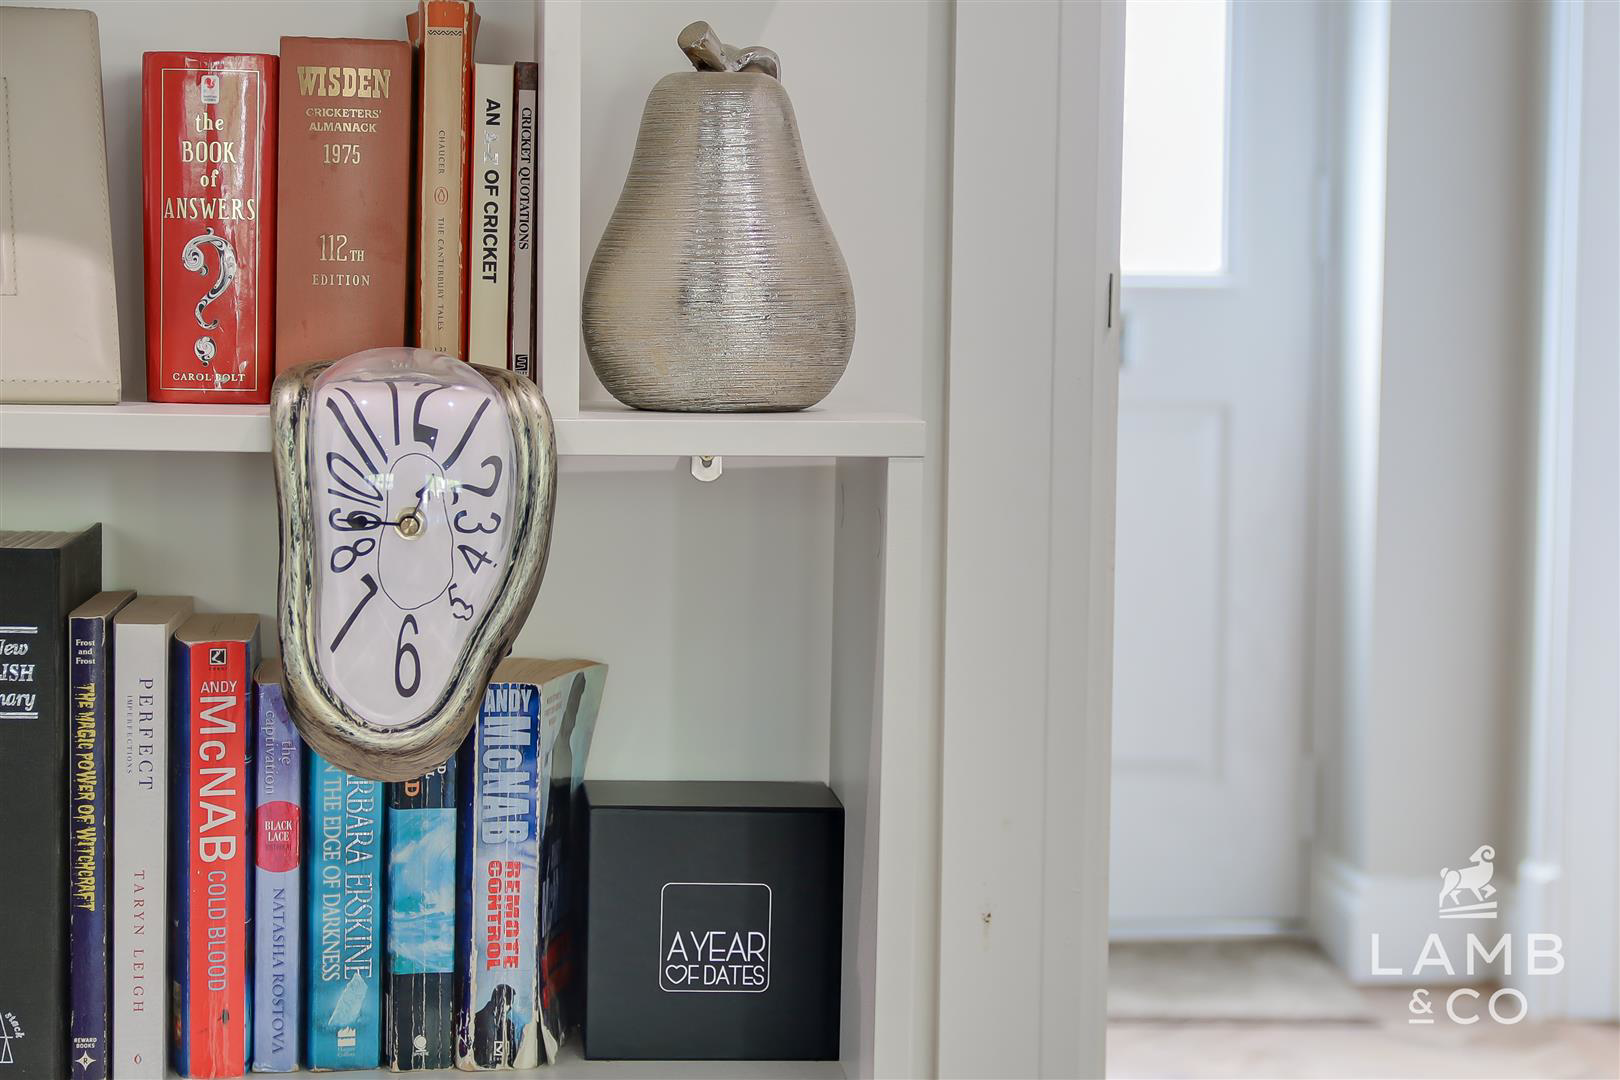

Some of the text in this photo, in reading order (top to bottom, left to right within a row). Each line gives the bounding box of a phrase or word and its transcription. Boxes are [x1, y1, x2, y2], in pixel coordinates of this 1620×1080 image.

[297, 66, 392, 98] WISDEN
[194, 112, 225, 131] the
[305, 107, 383, 119] CRICKETERS'
[485, 97, 501, 126] AN
[308, 122, 377, 133] ALMANACK
[181, 140, 237, 164] BOOK
[322, 143, 361, 165] 1975
[437, 129, 446, 175] CHAUCER
[199, 169, 219, 188] of
[483, 169, 500, 197] OF
[518, 107, 533, 250] CRICKET QUOTATIONS
[163, 197, 257, 221] ANSWERS
[437, 217, 445, 236] THE
[319, 234, 366, 262] 112TH
[481, 201, 499, 284] CRICKET
[311, 273, 371, 287] EDITION
[437, 238, 446, 300] CANTERBURY
[172, 372, 212, 382] CAROL
[451, 455, 504, 506] 2
[454, 509, 502, 535] 3
[330, 537, 376, 573] 8
[457, 544, 498, 575] 4
[329, 573, 379, 654] 7
[447, 582, 475, 622] 5
[75, 638, 96, 647] Frost
[393, 613, 423, 699] 6
[75, 656, 96, 665] Frost
[200, 680, 238, 693] ANDY
[483, 688, 533, 713] ANDY
[138, 678, 154, 790] PERFECT
[261, 710, 279, 795] captivation
[281, 740, 297, 766] the
[73, 682, 98, 912] THE MAGIC POWER OF WITCHCRAFT
[323, 778, 342, 812] THE
[264, 820, 293, 831] BLACK
[267, 831, 290, 842] LACE
[322, 816, 342, 861] EDGE
[322, 865, 342, 889] OF
[207, 870, 228, 921] COLD
[343, 873, 373, 981] ERSKINE
[486, 859, 503, 971] CONTROL
[503, 860, 522, 970] REMOTE
[132, 869, 145, 1012] TARYN LEIGH
[321, 893, 341, 982] DARKNESS
[666, 930, 766, 962] A YEAR
[207, 927, 228, 992] BLOOD
[271, 887, 285, 1054] NATASHA ROSTOVA
[703, 965, 765, 985] DATES
